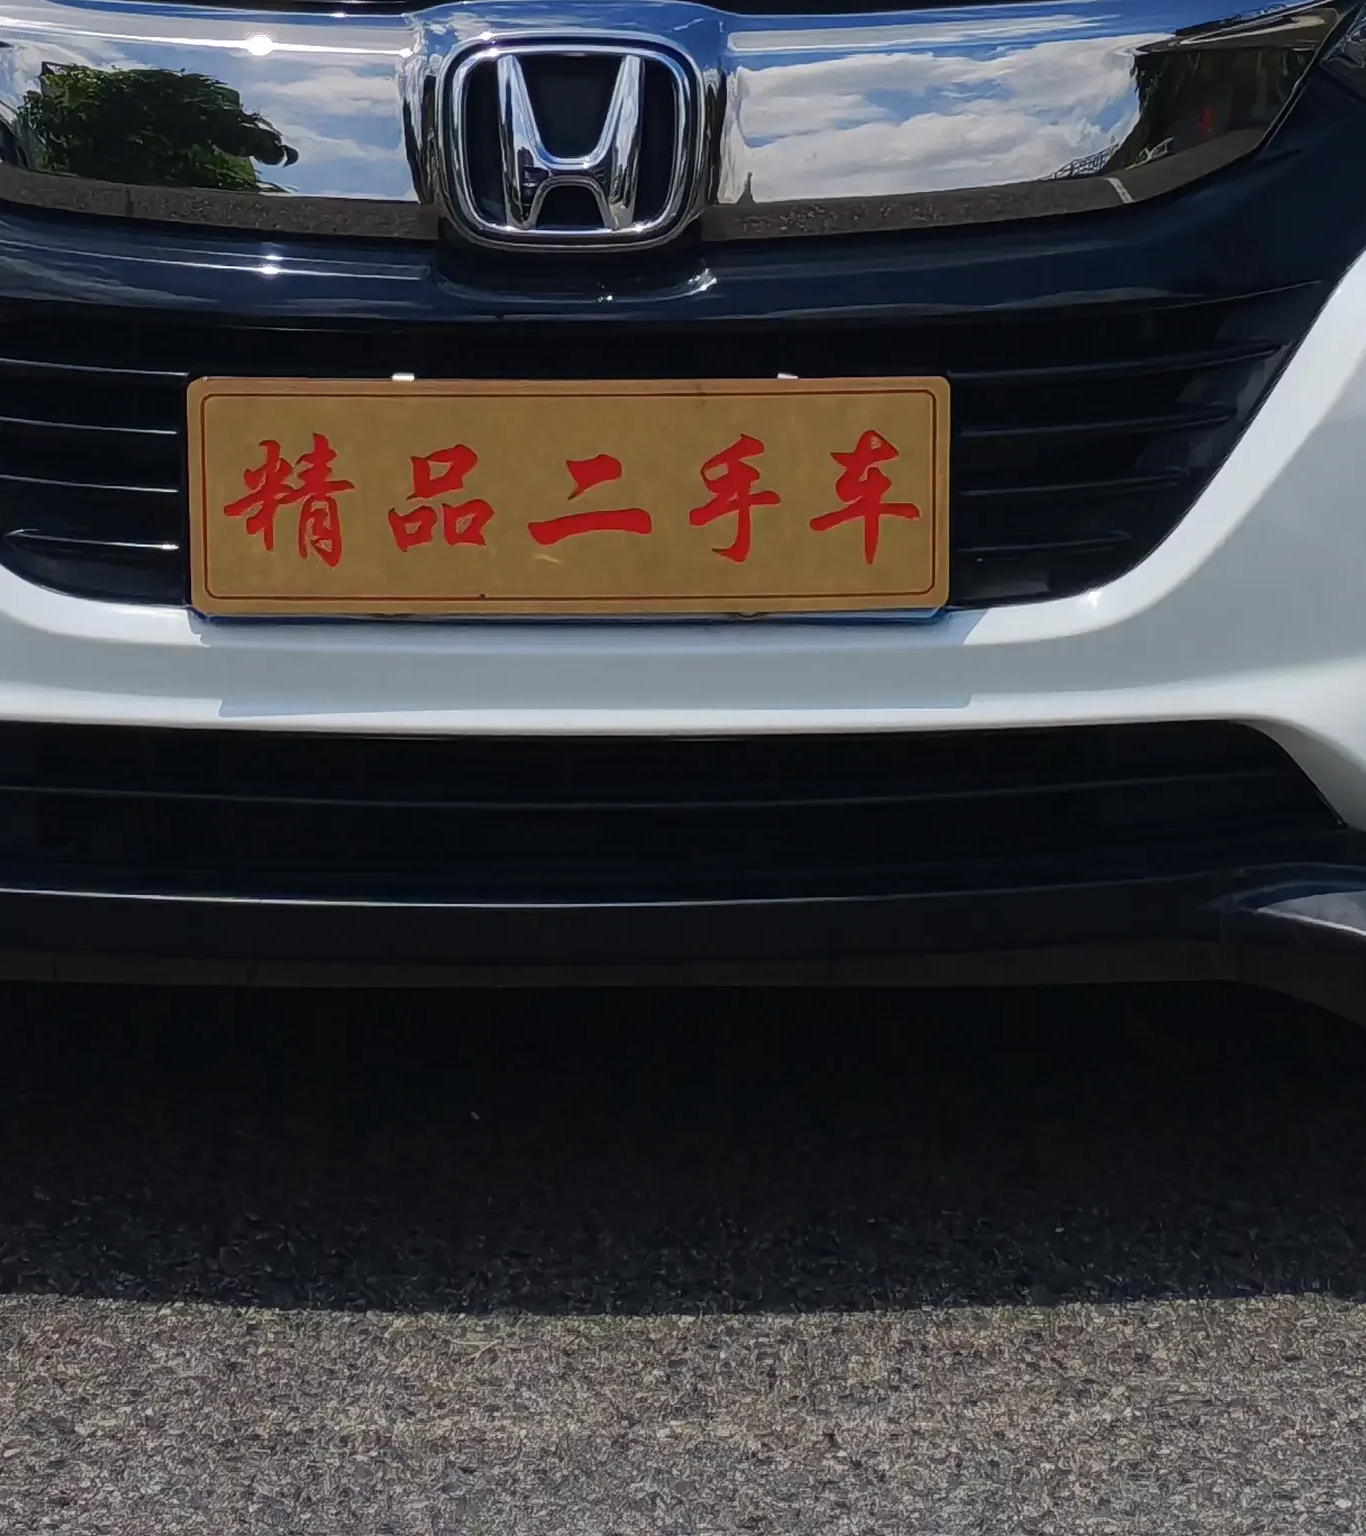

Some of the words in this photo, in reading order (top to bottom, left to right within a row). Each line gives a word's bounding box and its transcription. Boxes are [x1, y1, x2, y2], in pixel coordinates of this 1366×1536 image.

[224, 429, 921, 568] 精品二手车
